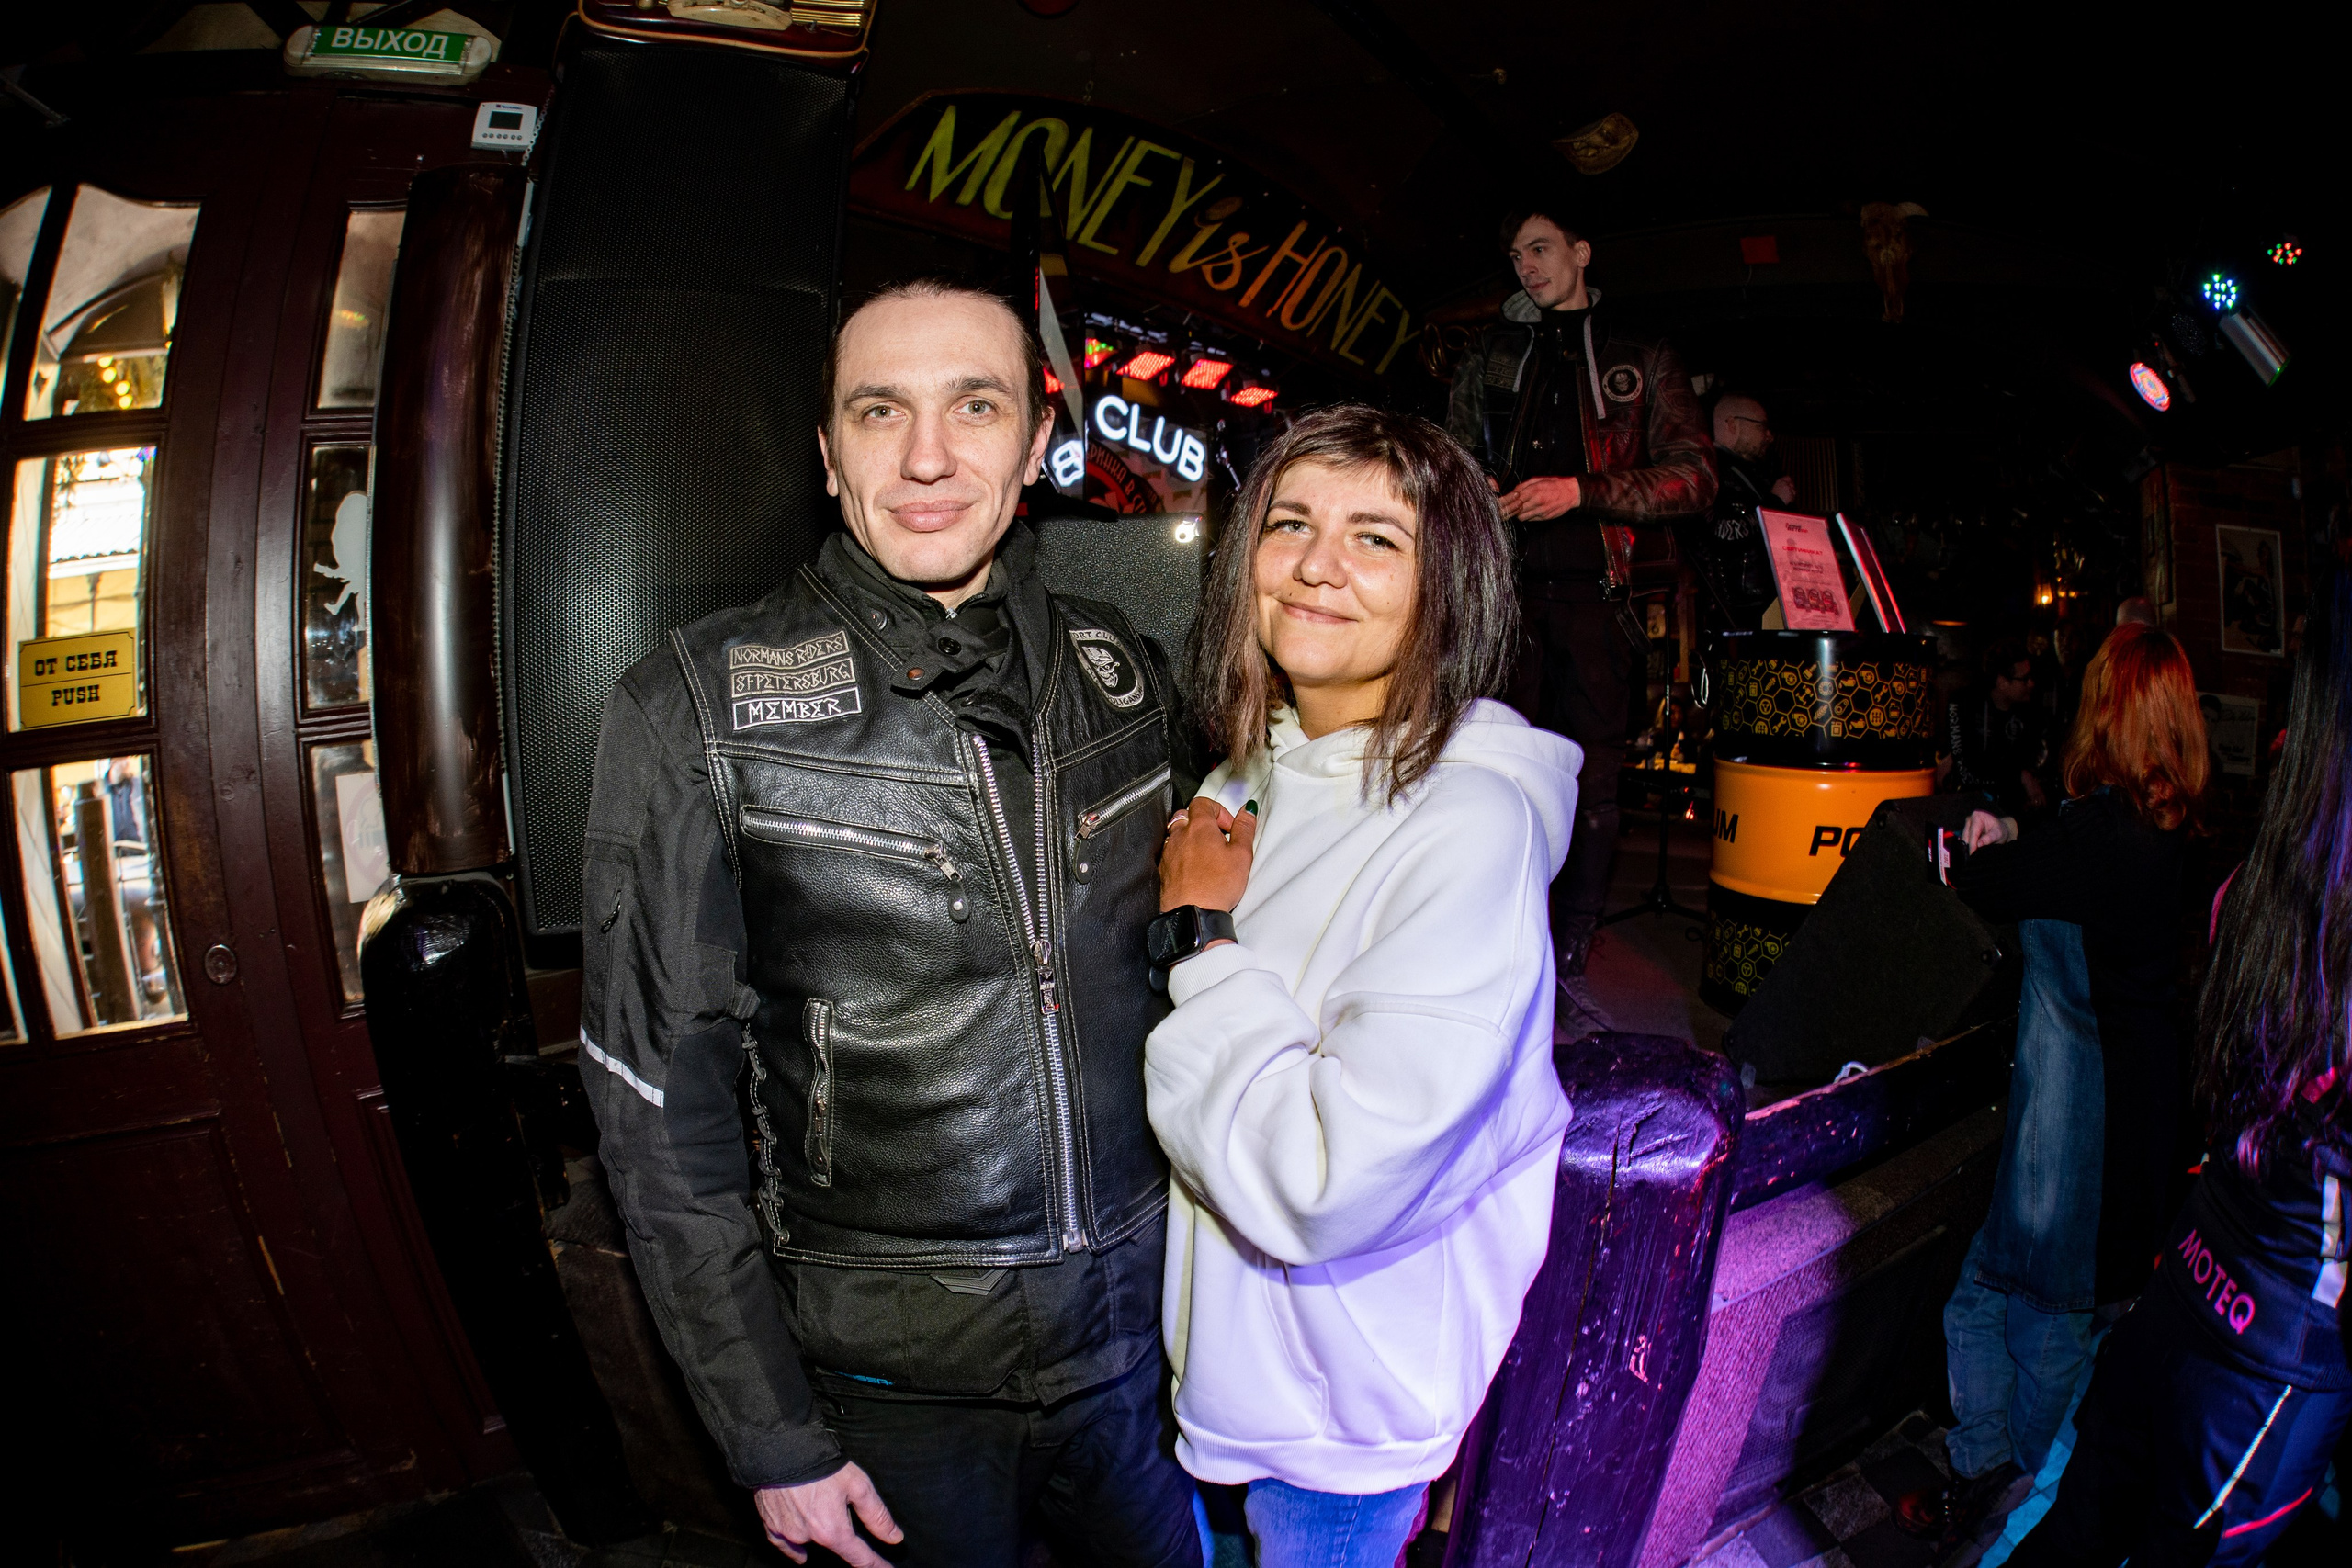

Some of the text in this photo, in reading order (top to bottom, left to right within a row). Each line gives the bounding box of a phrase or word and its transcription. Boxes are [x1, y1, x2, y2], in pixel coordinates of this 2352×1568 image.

[331, 27, 449, 59] ВЫХОД
[904, 104, 1421, 375] MONEY is HONEY
[1095, 395, 1205, 482] CLUB
[34, 650, 117, 676] ОТ СЕБЯ
[734, 636, 843, 666] NORMANS RIDERS
[51, 684, 99, 706] PUSH
[749, 698, 842, 724] MEMBER
[2177, 1228, 2256, 1335] MOTEQ
